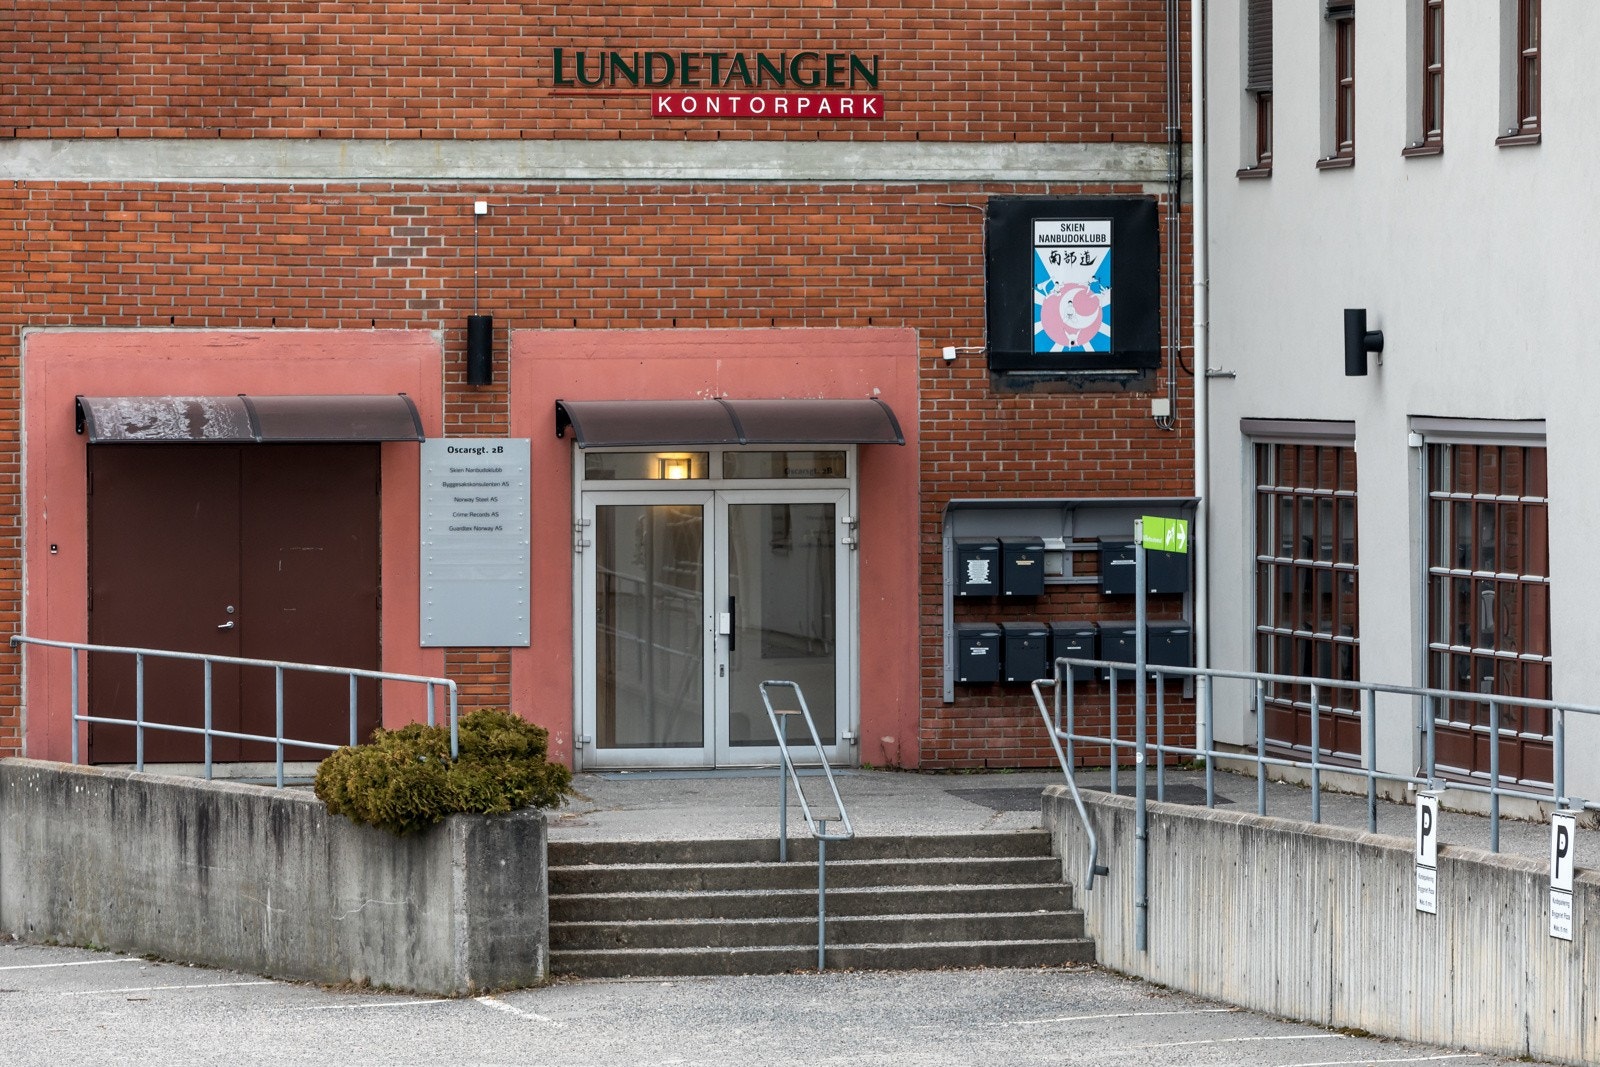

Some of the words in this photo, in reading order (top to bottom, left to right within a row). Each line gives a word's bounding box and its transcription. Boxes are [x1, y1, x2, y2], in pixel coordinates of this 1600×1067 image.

[552, 47, 880, 89] LUNDETANGEN
[658, 96, 878, 115] KONTORPARK
[1060, 223, 1085, 232] SKIEN
[1038, 234, 1106, 243] NANBUDOKLUBB
[447, 446, 488, 455] Oscarsgt.
[492, 446, 504, 454] 2B
[1420, 804, 1432, 856] P
[1555, 824, 1569, 879] P
